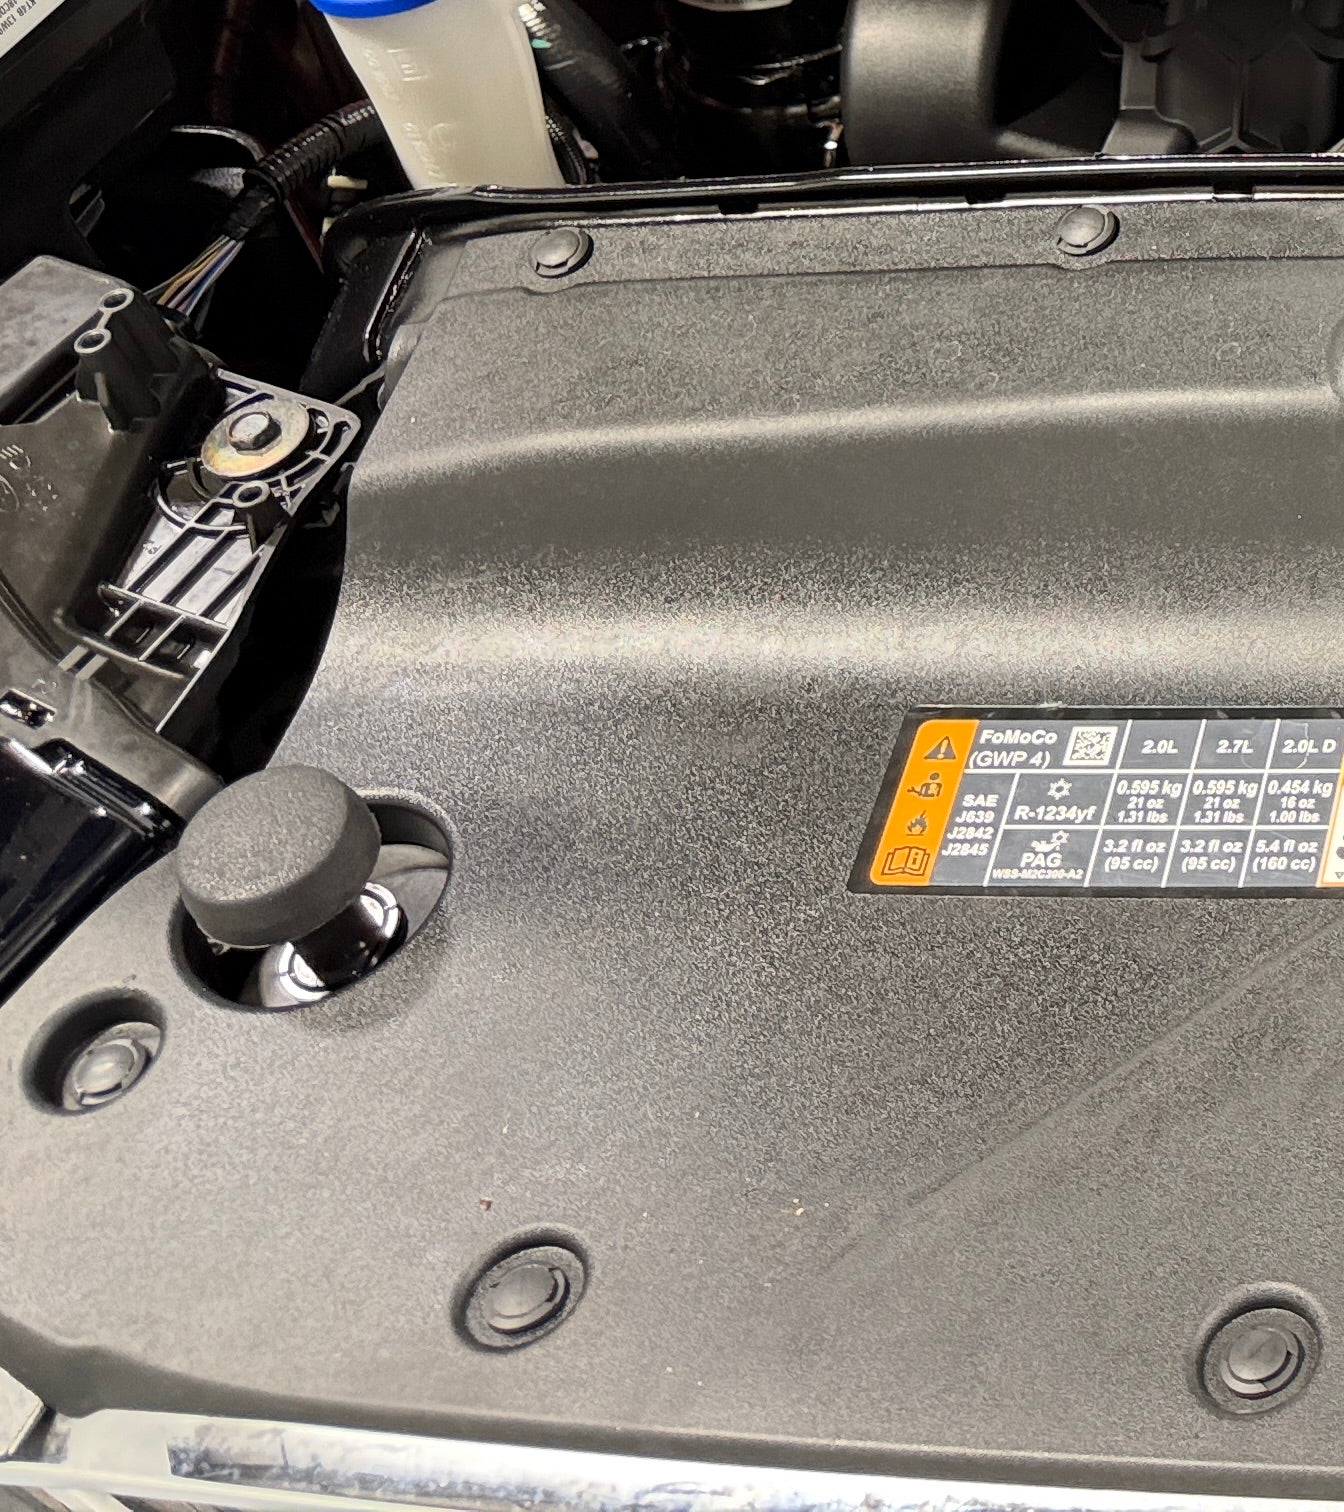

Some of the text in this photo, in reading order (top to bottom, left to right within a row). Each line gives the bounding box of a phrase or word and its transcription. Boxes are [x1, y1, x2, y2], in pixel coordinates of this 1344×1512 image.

[979, 729, 1058, 744] FoMoCo
[1141, 739, 1178, 754] 2.0L
[1216, 739, 1254, 754] 2.7L
[1281, 739, 1337, 754] 2.0L D
[969, 751, 1051, 769] (GWP 4)
[1116, 779, 1183, 798] 0.595 kg
[1192, 779, 1258, 798] 0.595 kg
[1267, 779, 1333, 798] 0.454 kg
[962, 794, 999, 807] SAE
[1127, 796, 1165, 809] 21 oz
[1203, 796, 1240, 809] 21 oz
[1280, 796, 1316, 809] 16 oz
[955, 810, 995, 823] J639
[1014, 804, 1097, 823] R-1234yf
[1117, 810, 1168, 823] 1.31 lbs
[1193, 810, 1244, 823] 1.31 lbs
[1269, 810, 1320, 823] 1.00 lbs
[946, 826, 994, 839] J2842
[941, 842, 989, 856] J2845
[1103, 839, 1167, 854] 3.2 fl oz
[1180, 839, 1243, 854] 3.2 fl oz
[1256, 839, 1318, 854] 5.4 fl oz
[1020, 851, 1063, 868] PAG
[1104, 856, 1158, 873] (95 cc)
[1181, 856, 1236, 873] (95 cc)
[1252, 856, 1316, 873] (160 cc)
